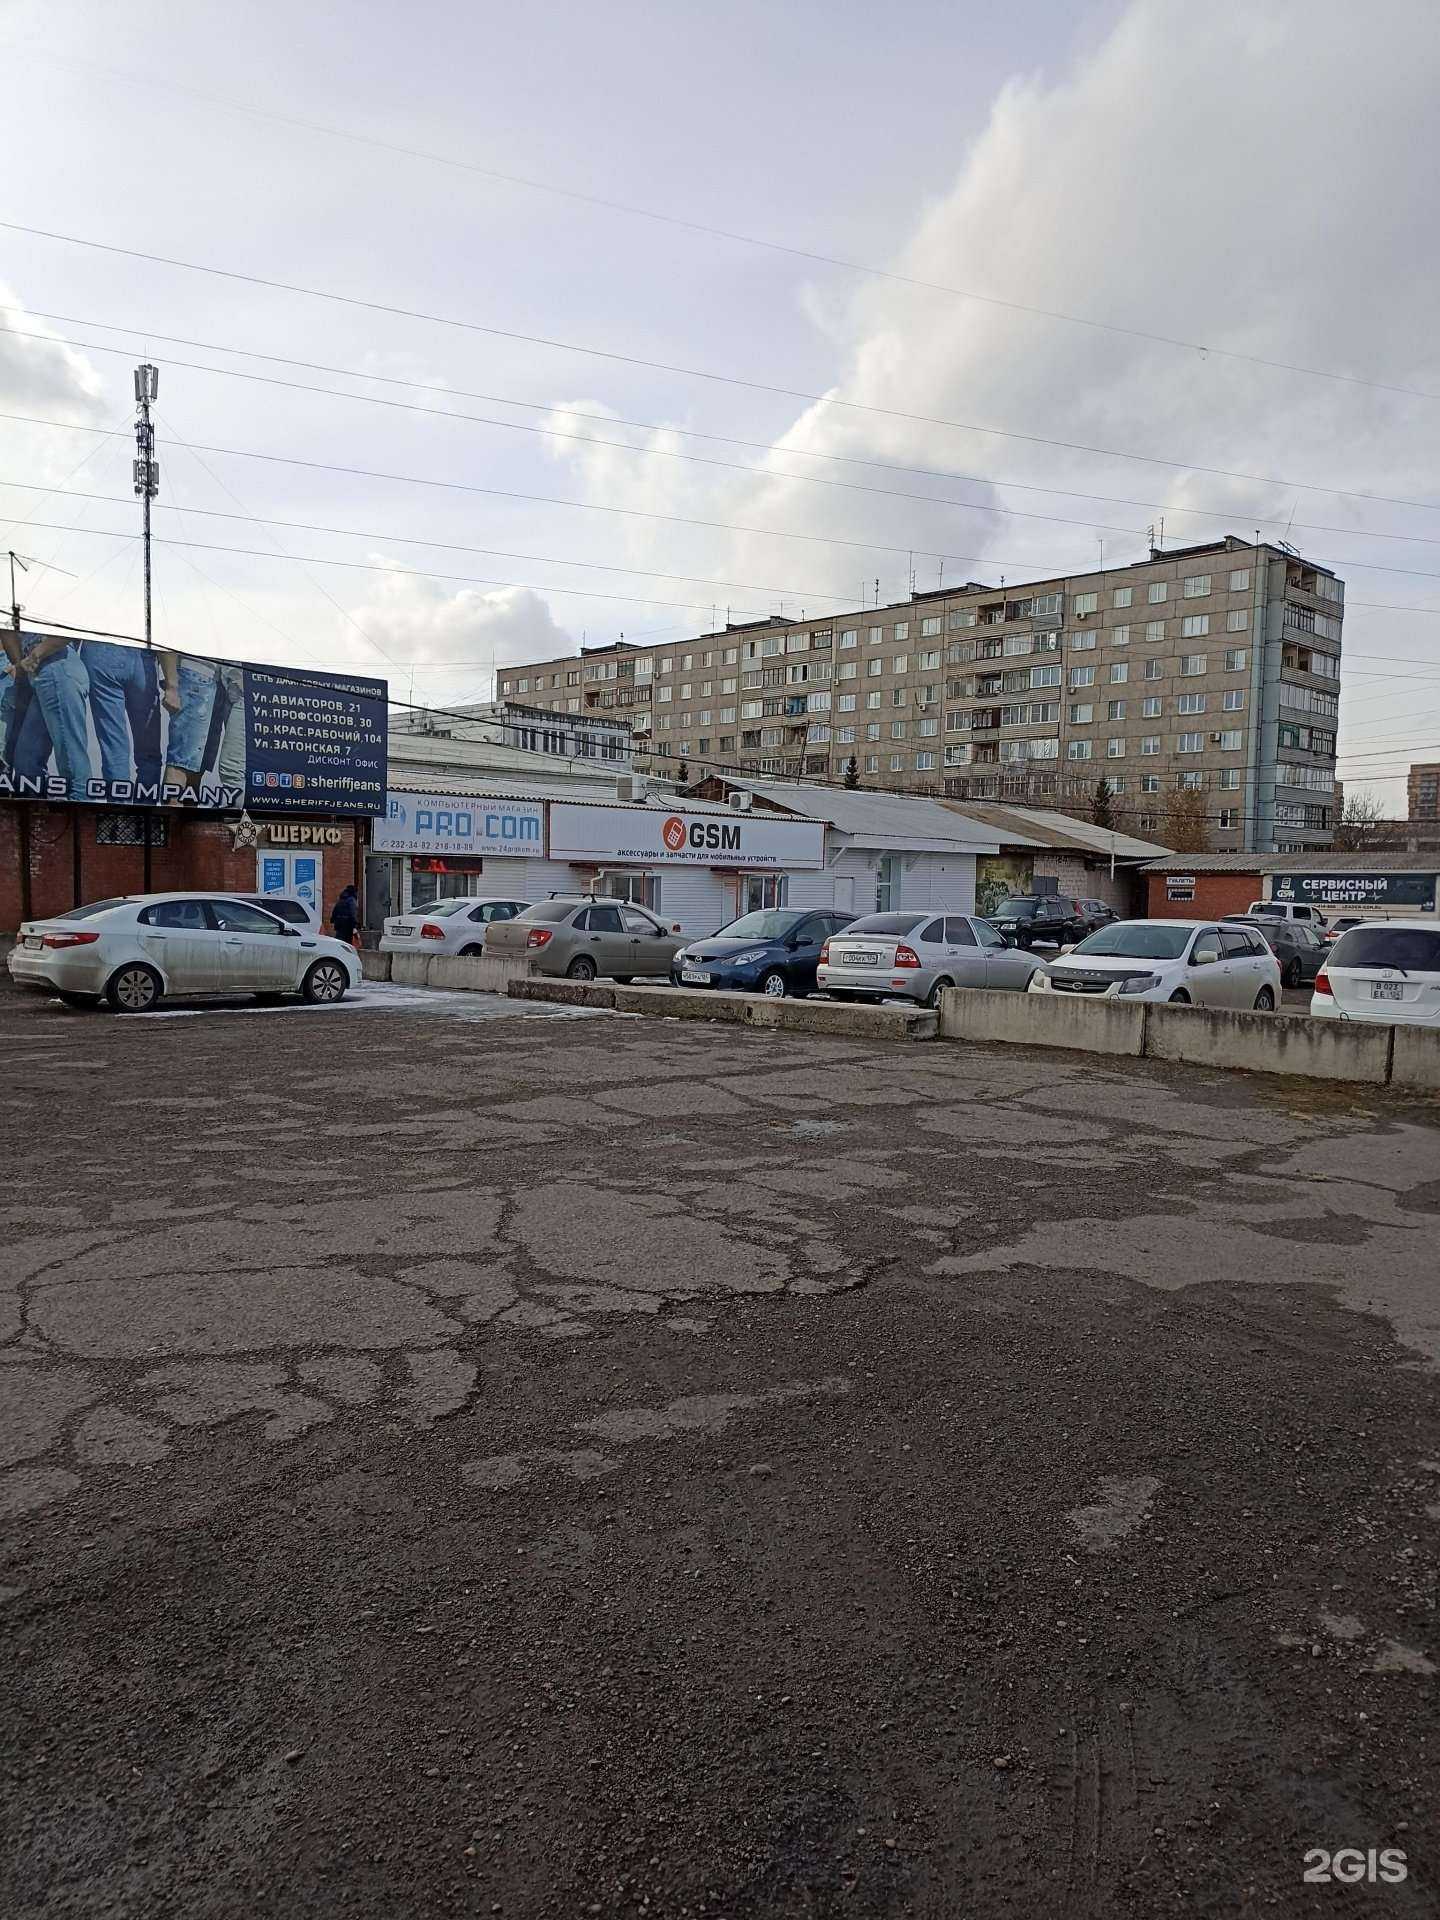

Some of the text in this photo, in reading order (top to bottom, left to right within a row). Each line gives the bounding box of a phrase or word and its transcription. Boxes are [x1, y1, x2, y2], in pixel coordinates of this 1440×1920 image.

[252, 673, 274, 683] СЕТЬ
[332, 682, 382, 695] МАГАЗИНОВ
[349, 703, 361, 713] 21
[359, 718, 372, 728] 30
[345, 746, 352, 755] 7
[307, 754, 379, 769] ДИСКОНТ ОФИС
[86, 778, 243, 804] COMPANY
[417, 799, 538, 813] КОМПЬЮТЕРНЫЙ МАГАЗИН
[689, 822, 741, 850] GSM
[617, 849, 658, 858] аксессуары
[666, 851, 696, 859] запчасти
[697, 852, 709, 860] для
[710, 852, 746, 861] мобильных
[747, 854, 777, 863] устройств
[1302, 878, 1388, 890] СЕРВИСНЫЙ
[1321, 890, 1366, 902] ЦЕНТР
